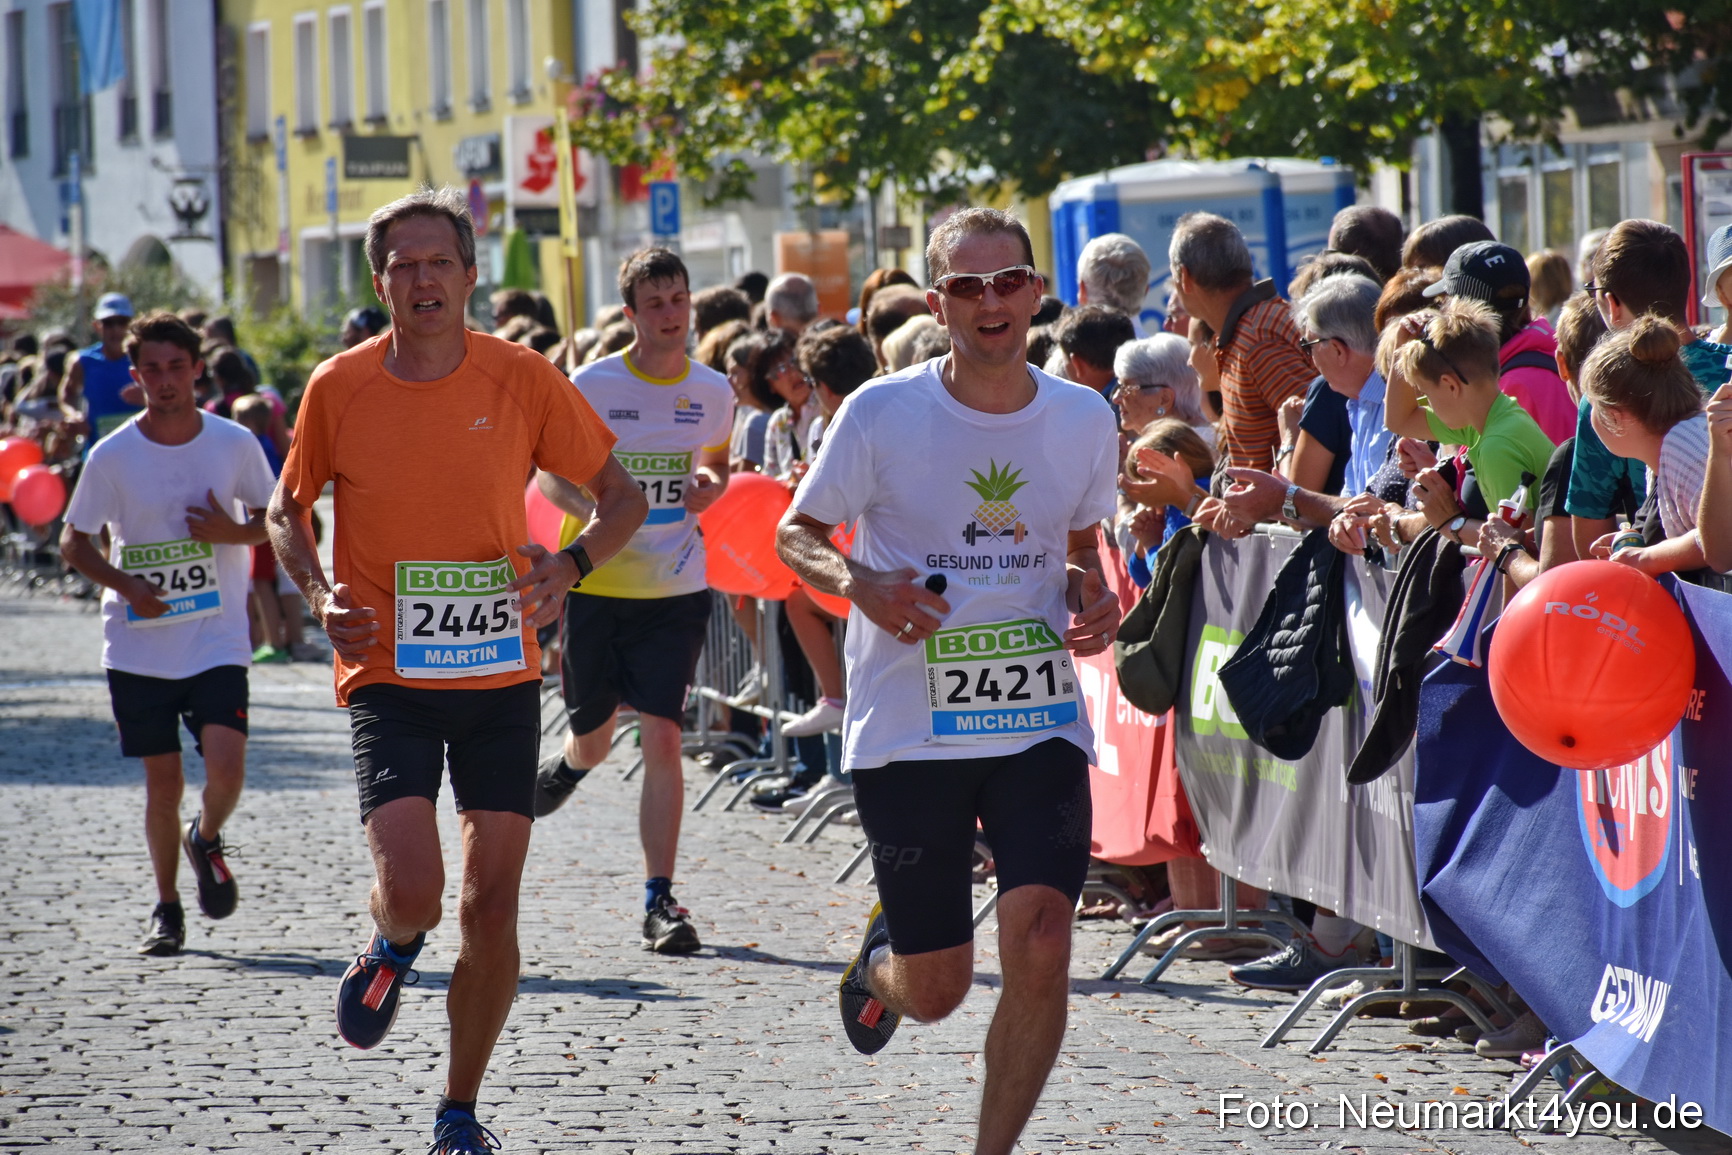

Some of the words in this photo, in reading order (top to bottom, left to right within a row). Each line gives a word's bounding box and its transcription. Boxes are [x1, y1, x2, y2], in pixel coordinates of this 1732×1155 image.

[127, 541, 206, 566] BOCK
[926, 554, 993, 570] GESUND
[999, 555, 1030, 569] UND
[133, 564, 207, 592] 249
[406, 562, 509, 593] BOCK
[968, 574, 991, 586] mit
[995, 572, 1021, 585] Julia
[168, 599, 196, 614] VIN
[412, 598, 510, 638] 2445
[936, 622, 1058, 659] BOCK
[424, 645, 498, 665] MARTIN
[944, 659, 1056, 704] 2421
[1684, 688, 1706, 721] RE
[955, 711, 1057, 731] MICHAEL
[1081, 661, 1120, 777] DL
